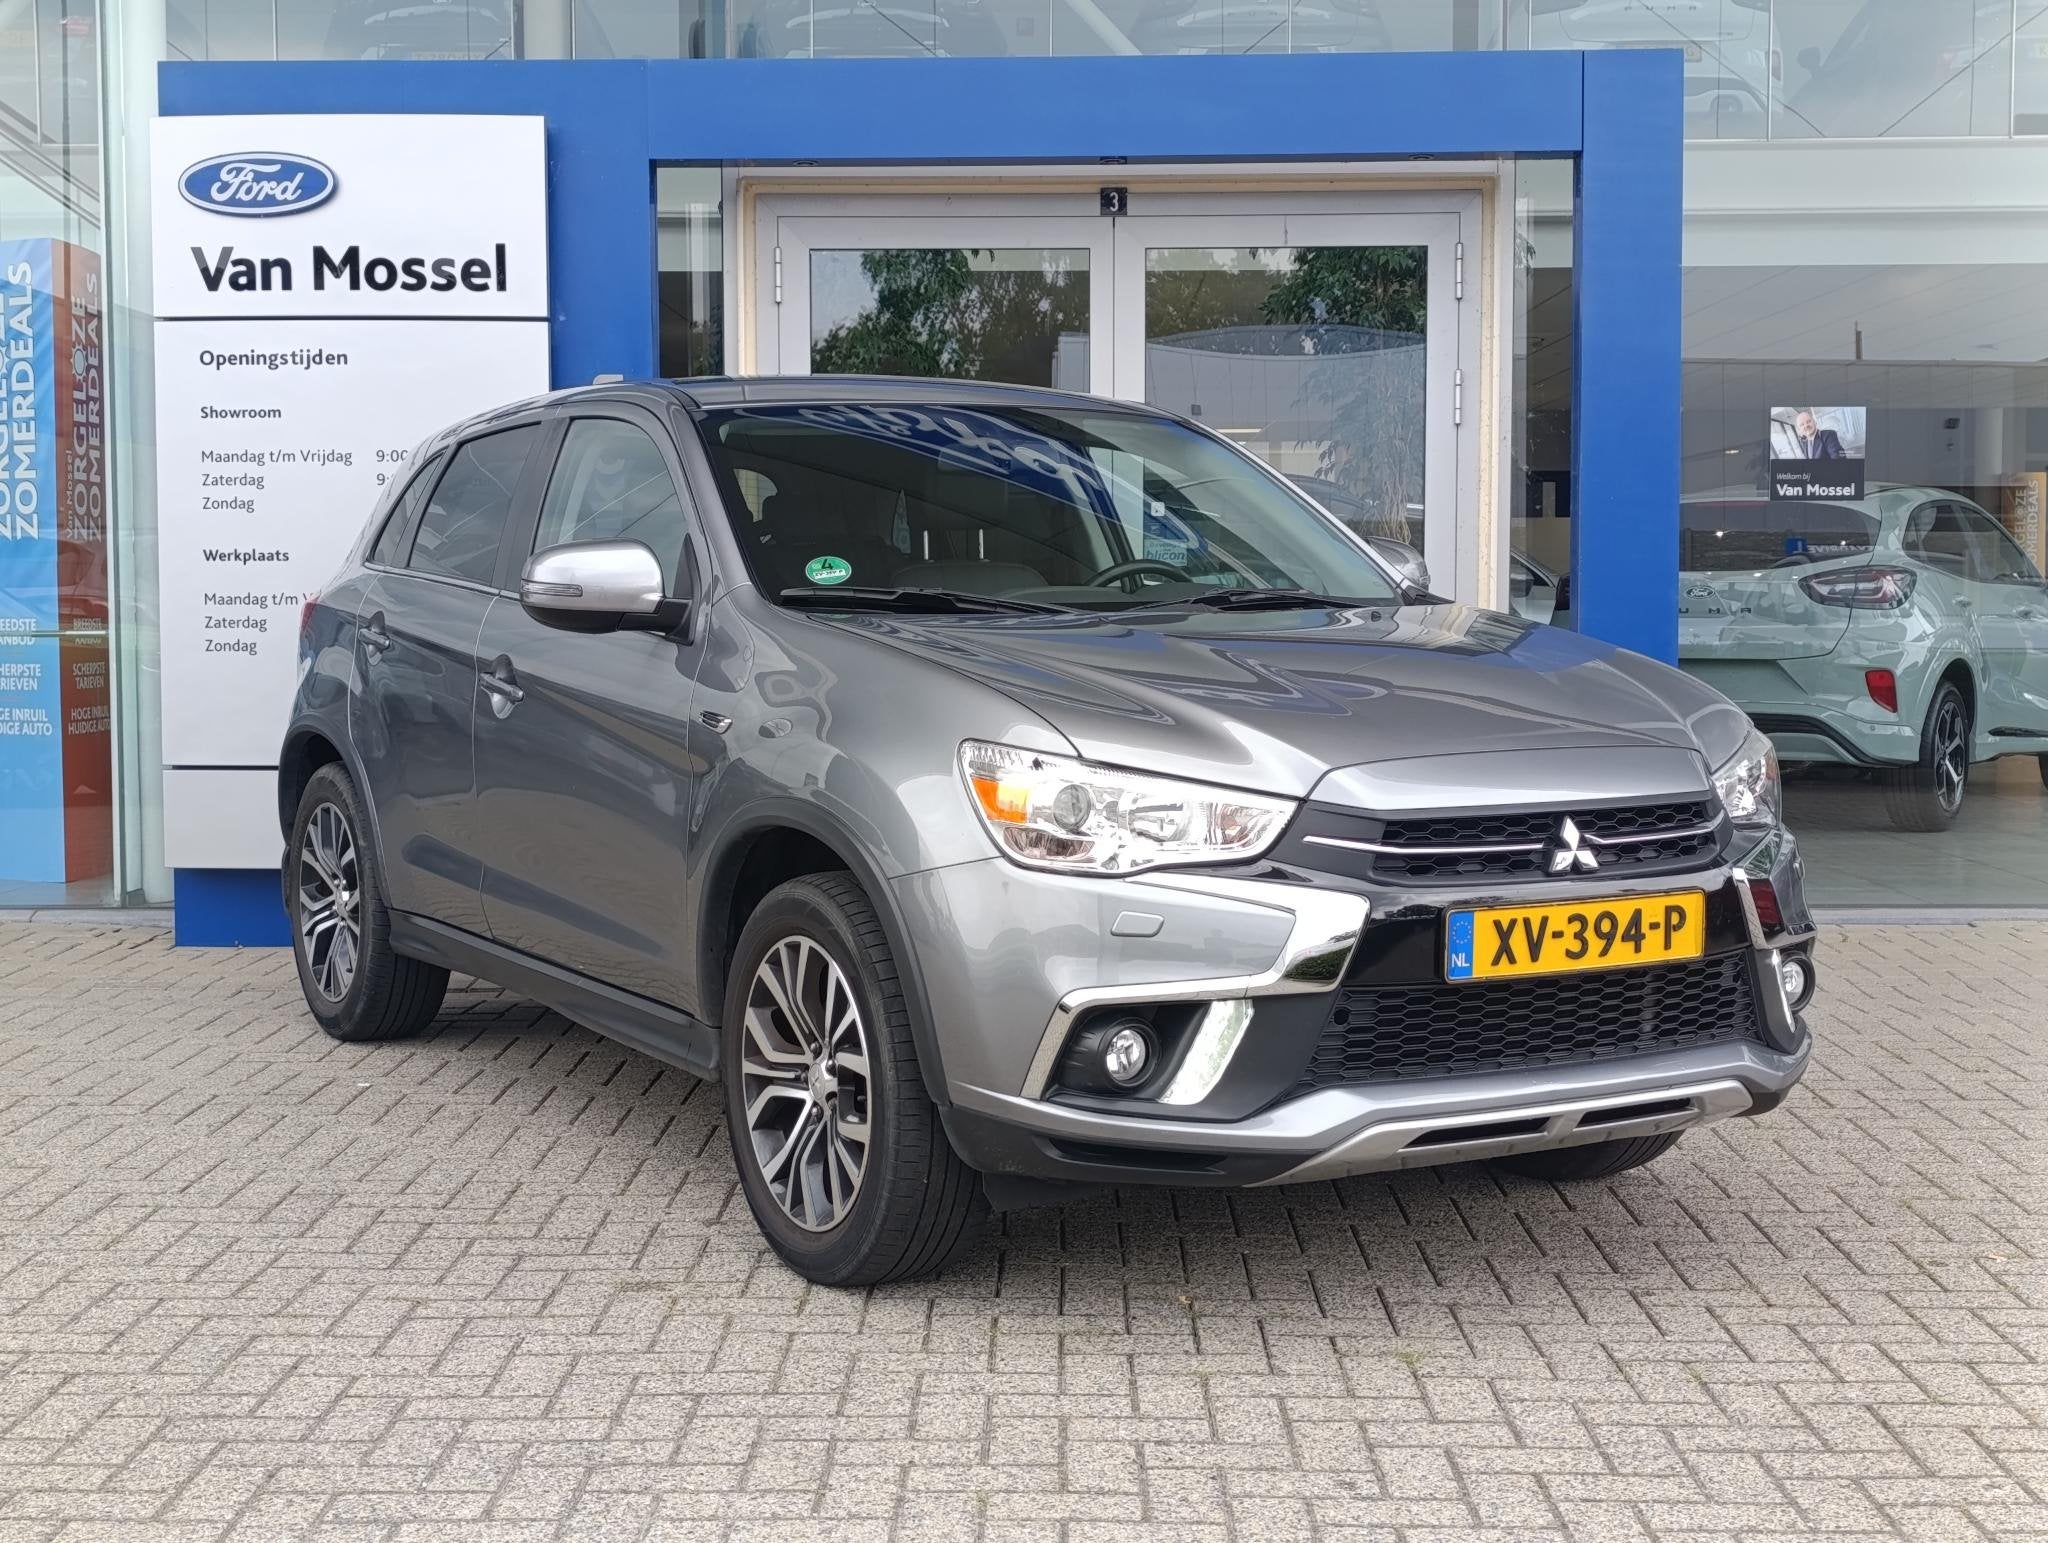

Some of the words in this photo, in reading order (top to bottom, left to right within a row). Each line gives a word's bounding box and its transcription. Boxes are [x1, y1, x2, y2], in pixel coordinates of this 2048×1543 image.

[211, 161, 305, 202] Ford
[1110, 191, 1119, 212] 3
[190, 246, 293, 292] Van
[312, 243, 507, 292] Mossel
[199, 349, 348, 371] Openingstijden
[8, 261, 39, 541] ZOMERDEALS
[86, 272, 102, 542] ZOMERDEALS
[200, 405, 282, 419] Showroom
[201, 449, 265, 467] Maandag
[269, 449, 296, 463] t/m
[300, 449, 353, 467] Vrijdag
[202, 473, 265, 490] Zaterdag
[1776, 472, 1802, 480] Welkom
[1776, 483, 1802, 496] Van
[1806, 482, 1856, 496] Mossel
[202, 496, 255, 513] Zondag
[203, 548, 290, 566] Werkplaats
[821, 558, 834, 570] 4
[204, 592, 268, 609] Maandag
[272, 592, 298, 606] t/m
[1687, 587, 1711, 598] Ford
[205, 615, 267, 633] Zaterdag
[205, 638, 257, 656] Zondag
[12, 707, 48, 721] INRUIL
[71, 706, 91, 721] HOGE
[22, 722, 53, 736] AUTO
[1491, 905, 1687, 967] XV-394-P
[1451, 953, 1471, 967] NL
